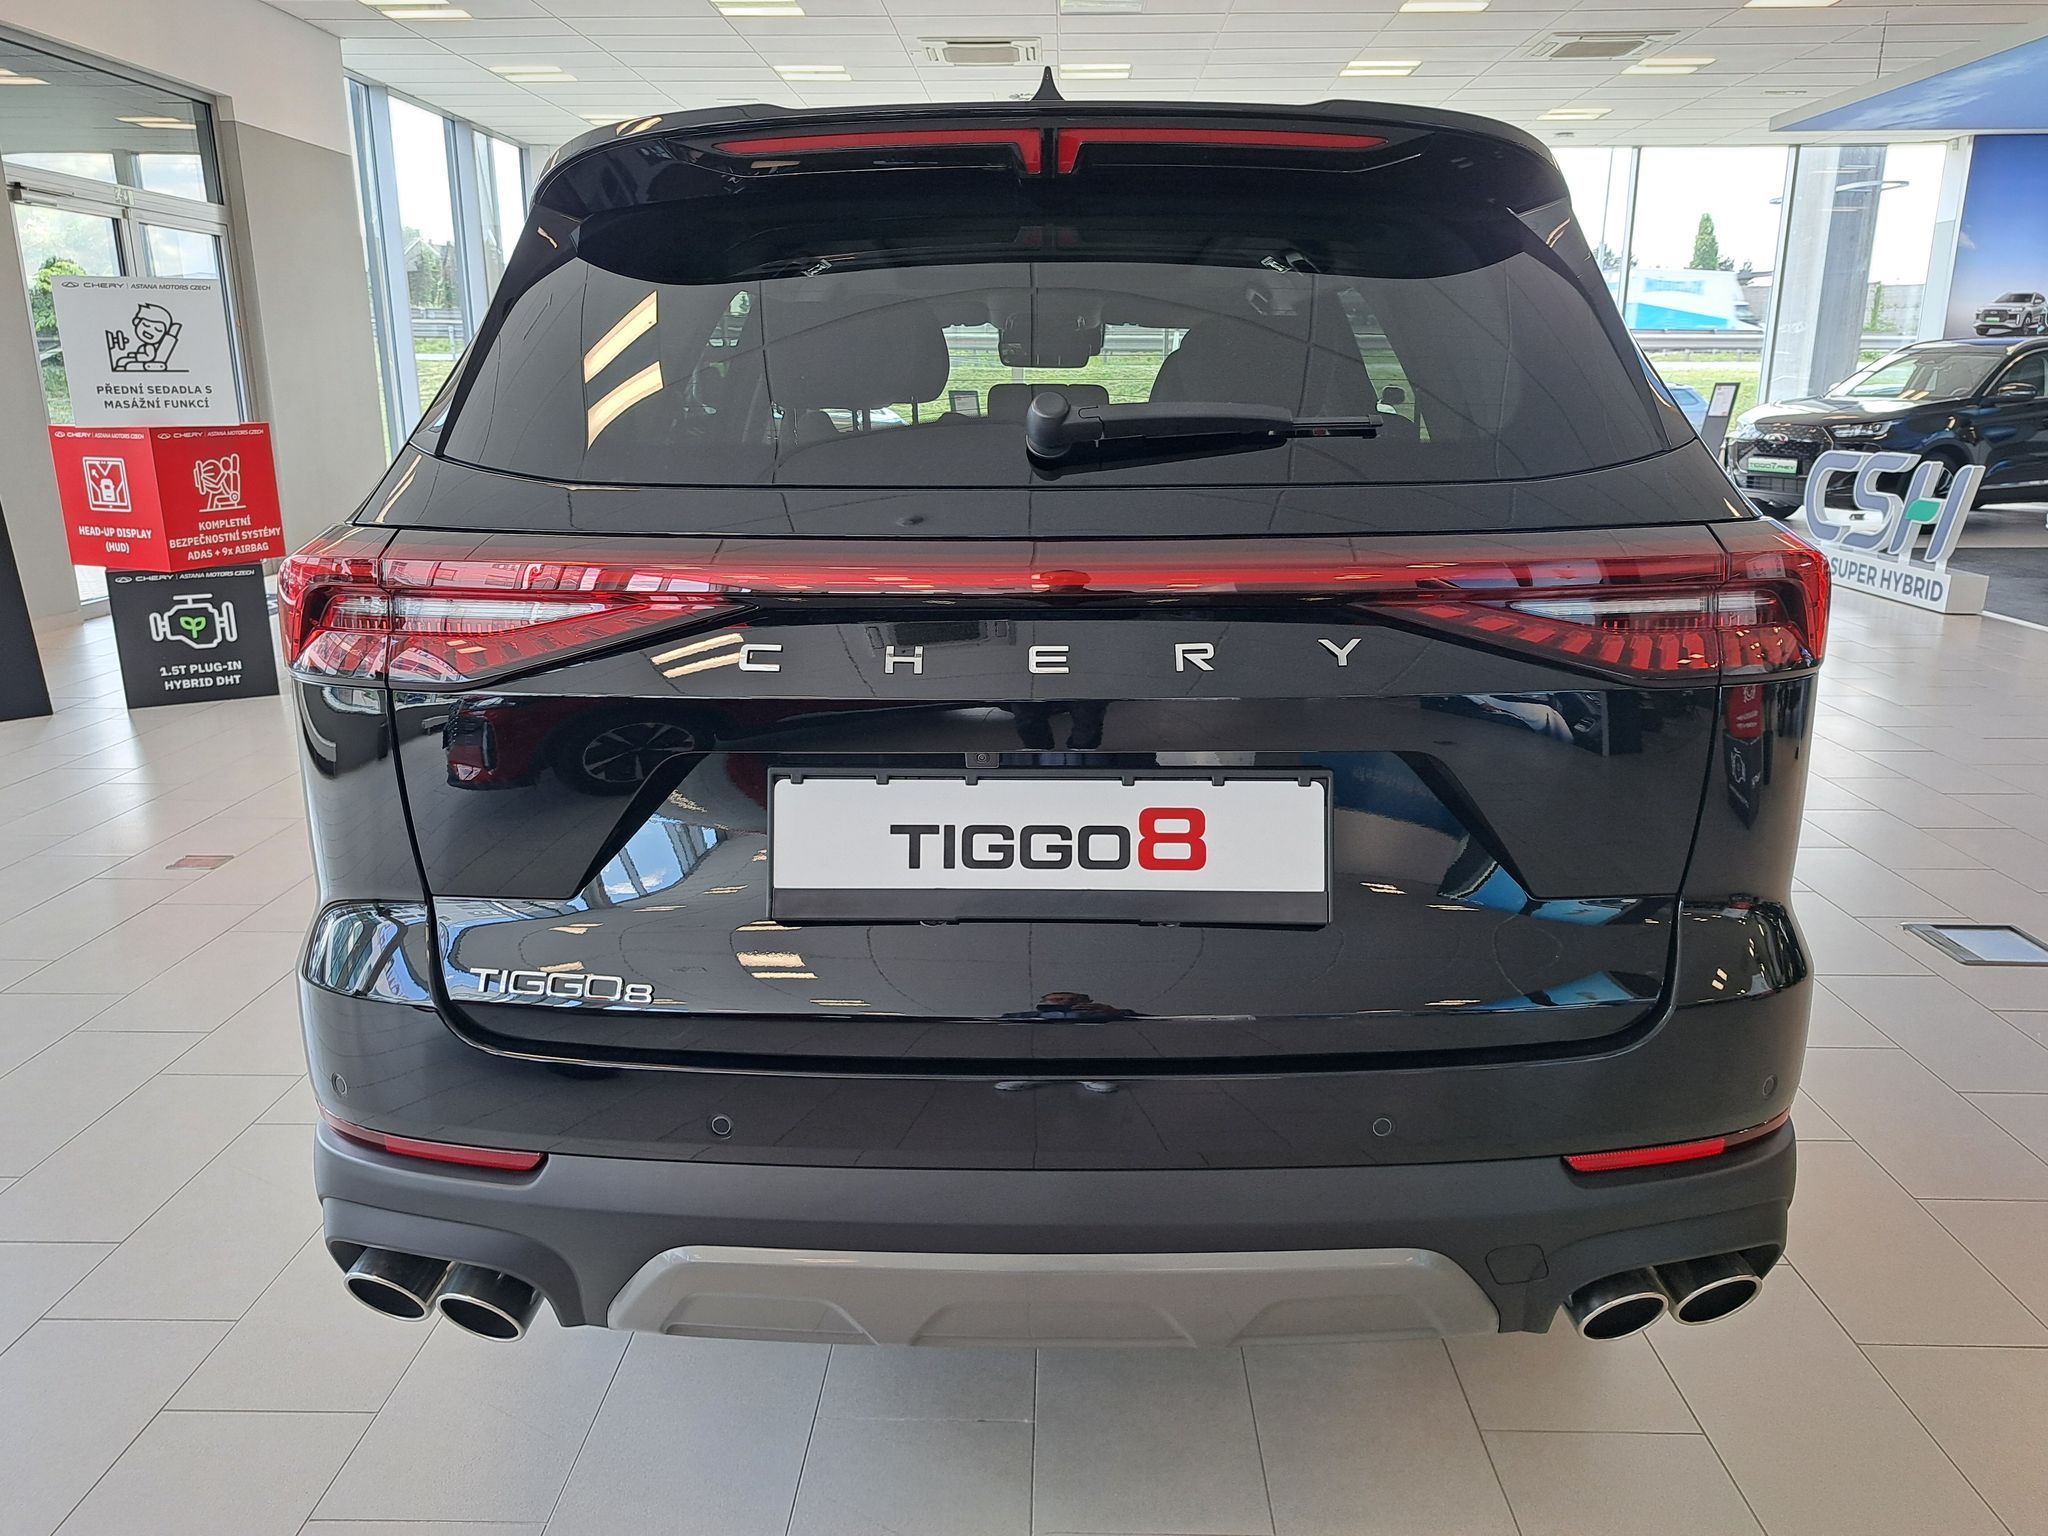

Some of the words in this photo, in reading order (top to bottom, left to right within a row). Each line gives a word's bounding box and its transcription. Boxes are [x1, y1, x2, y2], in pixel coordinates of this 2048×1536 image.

[96, 382, 144, 395] PŘEDNÍ
[146, 385, 202, 395] SEDADLA
[205, 385, 212, 394] S
[104, 397, 160, 409] MASÁŽNÍ
[164, 397, 210, 409] FUNKCÍ
[1805, 450, 1987, 564] CSH
[198, 514, 252, 531] KOMPLETNÍ
[78, 526, 115, 537] HEAD-UP
[116, 529, 152, 539] DISPLAY
[169, 529, 240, 549] BEZPEČNOSTNÍ
[241, 525, 281, 540] SYSTÉMY
[105, 542, 130, 554] (HUD)
[187, 549, 213, 561] ADAS
[222, 547, 234, 556] 9x
[235, 542, 269, 554] AIRBAG
[135, 574, 174, 582] CHERY
[179, 572, 205, 580] ASTANA
[1831, 556, 1878, 587] SUPER
[1879, 571, 1944, 602] HYBRID
[738, 637, 1362, 674] CHERY
[159, 664, 187, 677] 1.5T
[189, 660, 242, 675] PLUG-IN
[164, 677, 214, 690] HYBRID
[216, 674, 242, 686] DHT
[889, 806, 1208, 871] TIGGO8
[469, 967, 655, 1004] TIGGO8
